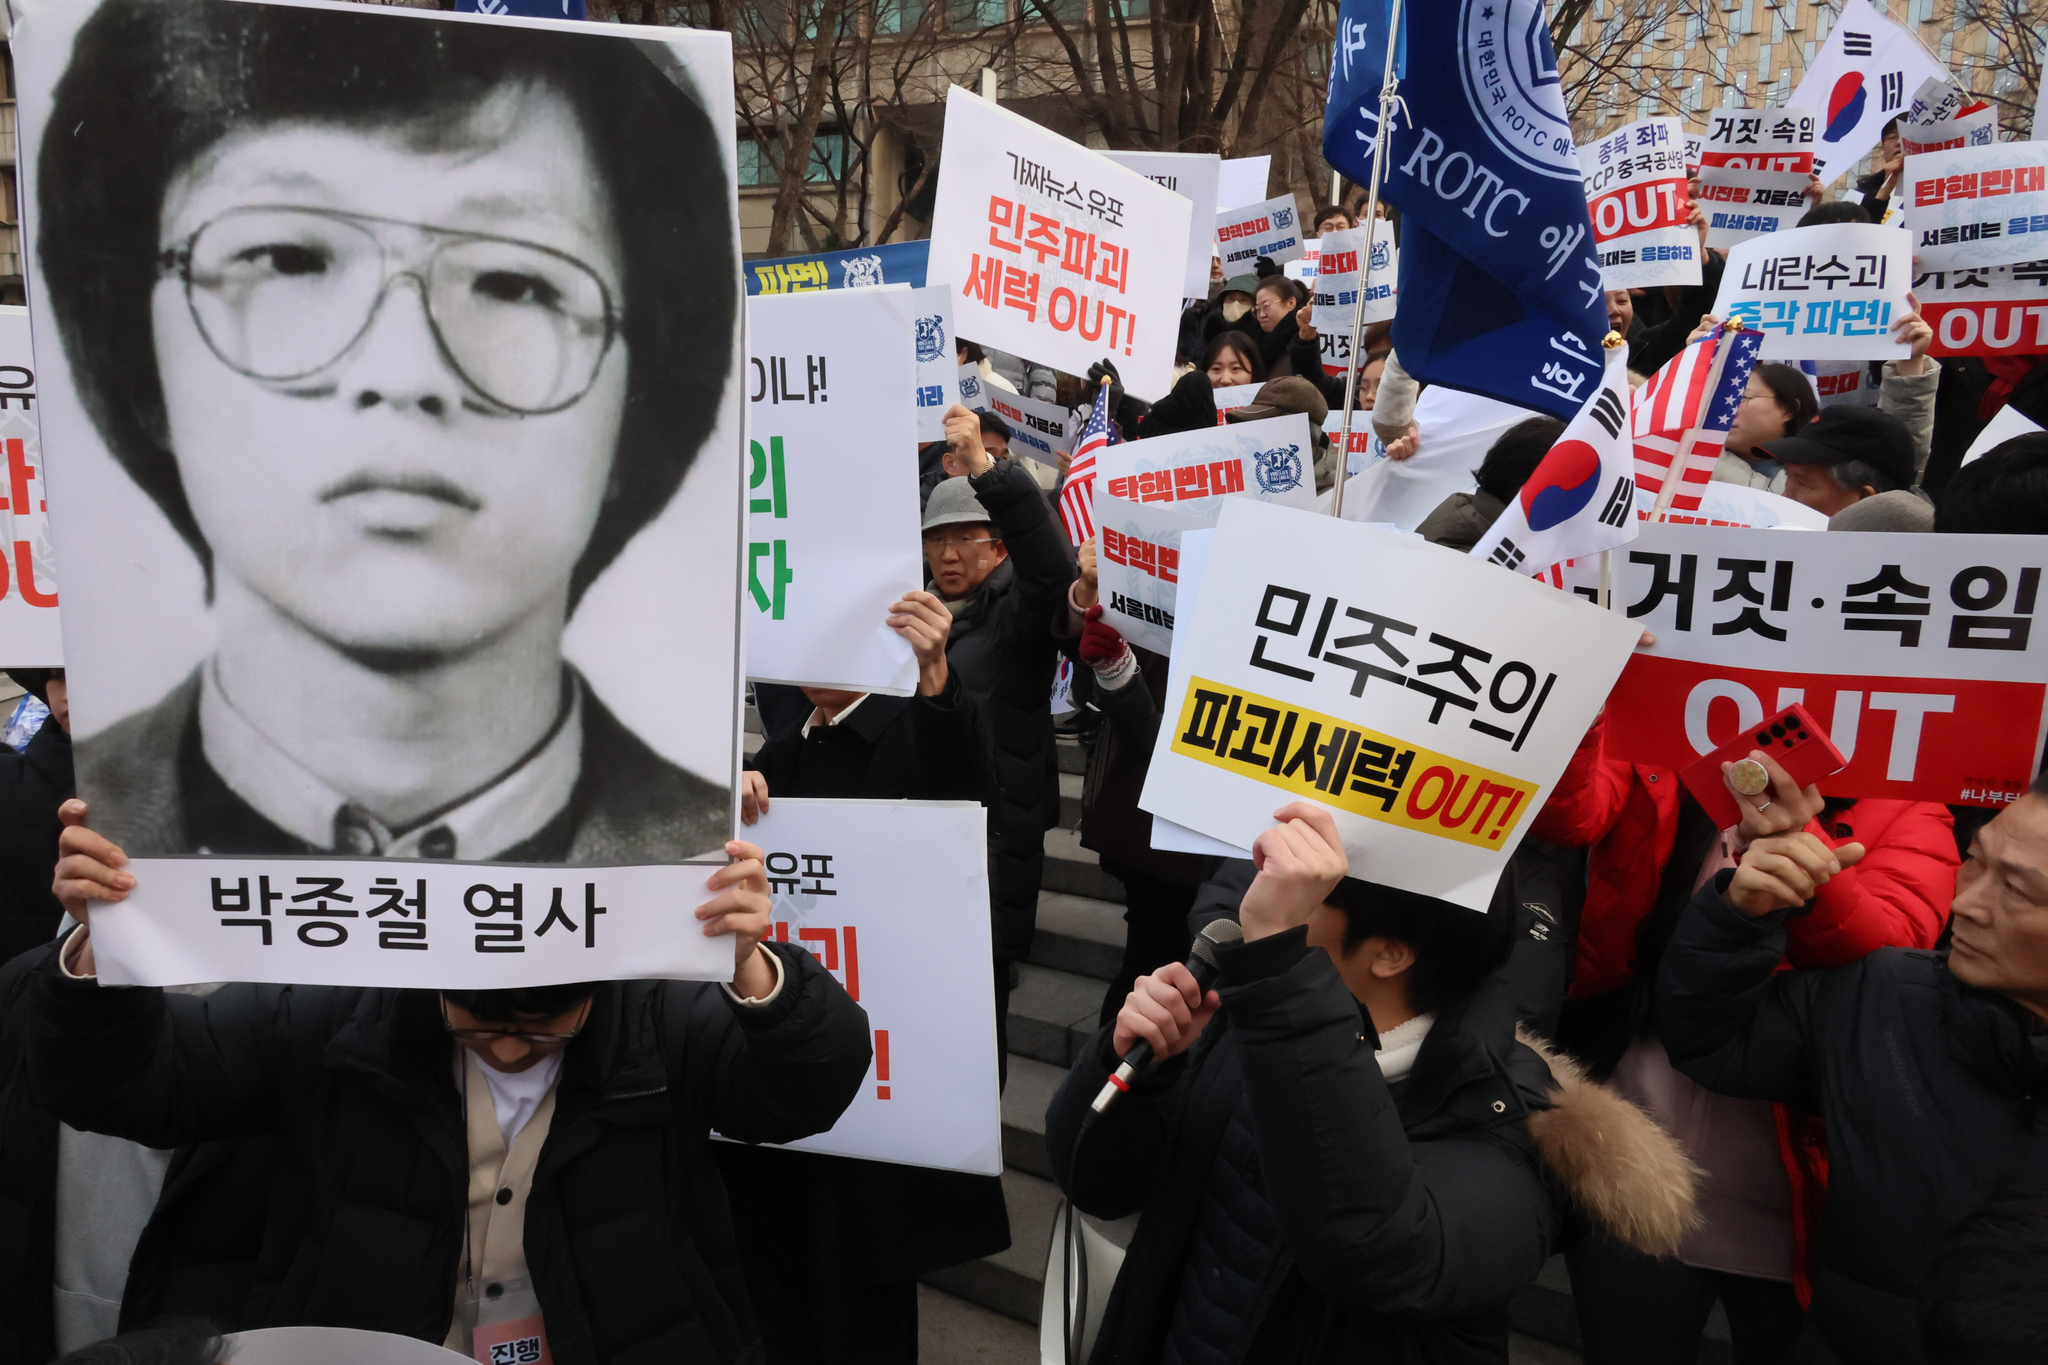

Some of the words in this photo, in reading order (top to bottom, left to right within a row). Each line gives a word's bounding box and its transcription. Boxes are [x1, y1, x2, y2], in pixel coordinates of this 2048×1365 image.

[1478, 31, 1508, 106] 대한민국
[1502, 105, 1547, 147] ROTC
[1599, 132, 1629, 165] 종북
[1636, 123, 1669, 147] 좌파
[1710, 117, 1815, 144] 거짓·속임
[1006, 151, 1084, 210] 가짜뉴스
[1087, 189, 1124, 228] 유포
[1400, 127, 1530, 238] ROTC
[1583, 165, 1615, 197] CCP
[1617, 150, 1684, 180] 중국공산당
[1915, 166, 2046, 207] 탄핵반대
[1596, 182, 1677, 237] OUT
[1698, 185, 1751, 203] 시진핑
[1752, 189, 1805, 207] 자료실
[1217, 216, 1271, 242] 탄핵반대
[1710, 213, 1779, 232] 폐쇄하라
[1920, 222, 2002, 247] 서울대는
[987, 195, 1130, 294] 민주파괴
[1641, 246, 1693, 262] 응답하라
[755, 261, 829, 296] 파면!
[1741, 255, 1887, 291] 내란수괴
[962, 254, 1041, 323] 세력
[1048, 286, 1136, 358] OUT!
[1802, 299, 1892, 337] 파면!
[1024, 412, 1063, 438] 자료실
[1108, 458, 1245, 504] 탄핵반대
[1627, 550, 2043, 652] 거짓·속임
[1249, 583, 1558, 753] 민주주의
[1181, 688, 1416, 813] 파괴세력
[1405, 765, 1525, 841] OUT!
[765, 852, 838, 897] 유포
[210, 875, 430, 951] 박종철
[463, 881, 607, 953] 열사
[492, 1337, 541, 1365] 진행
